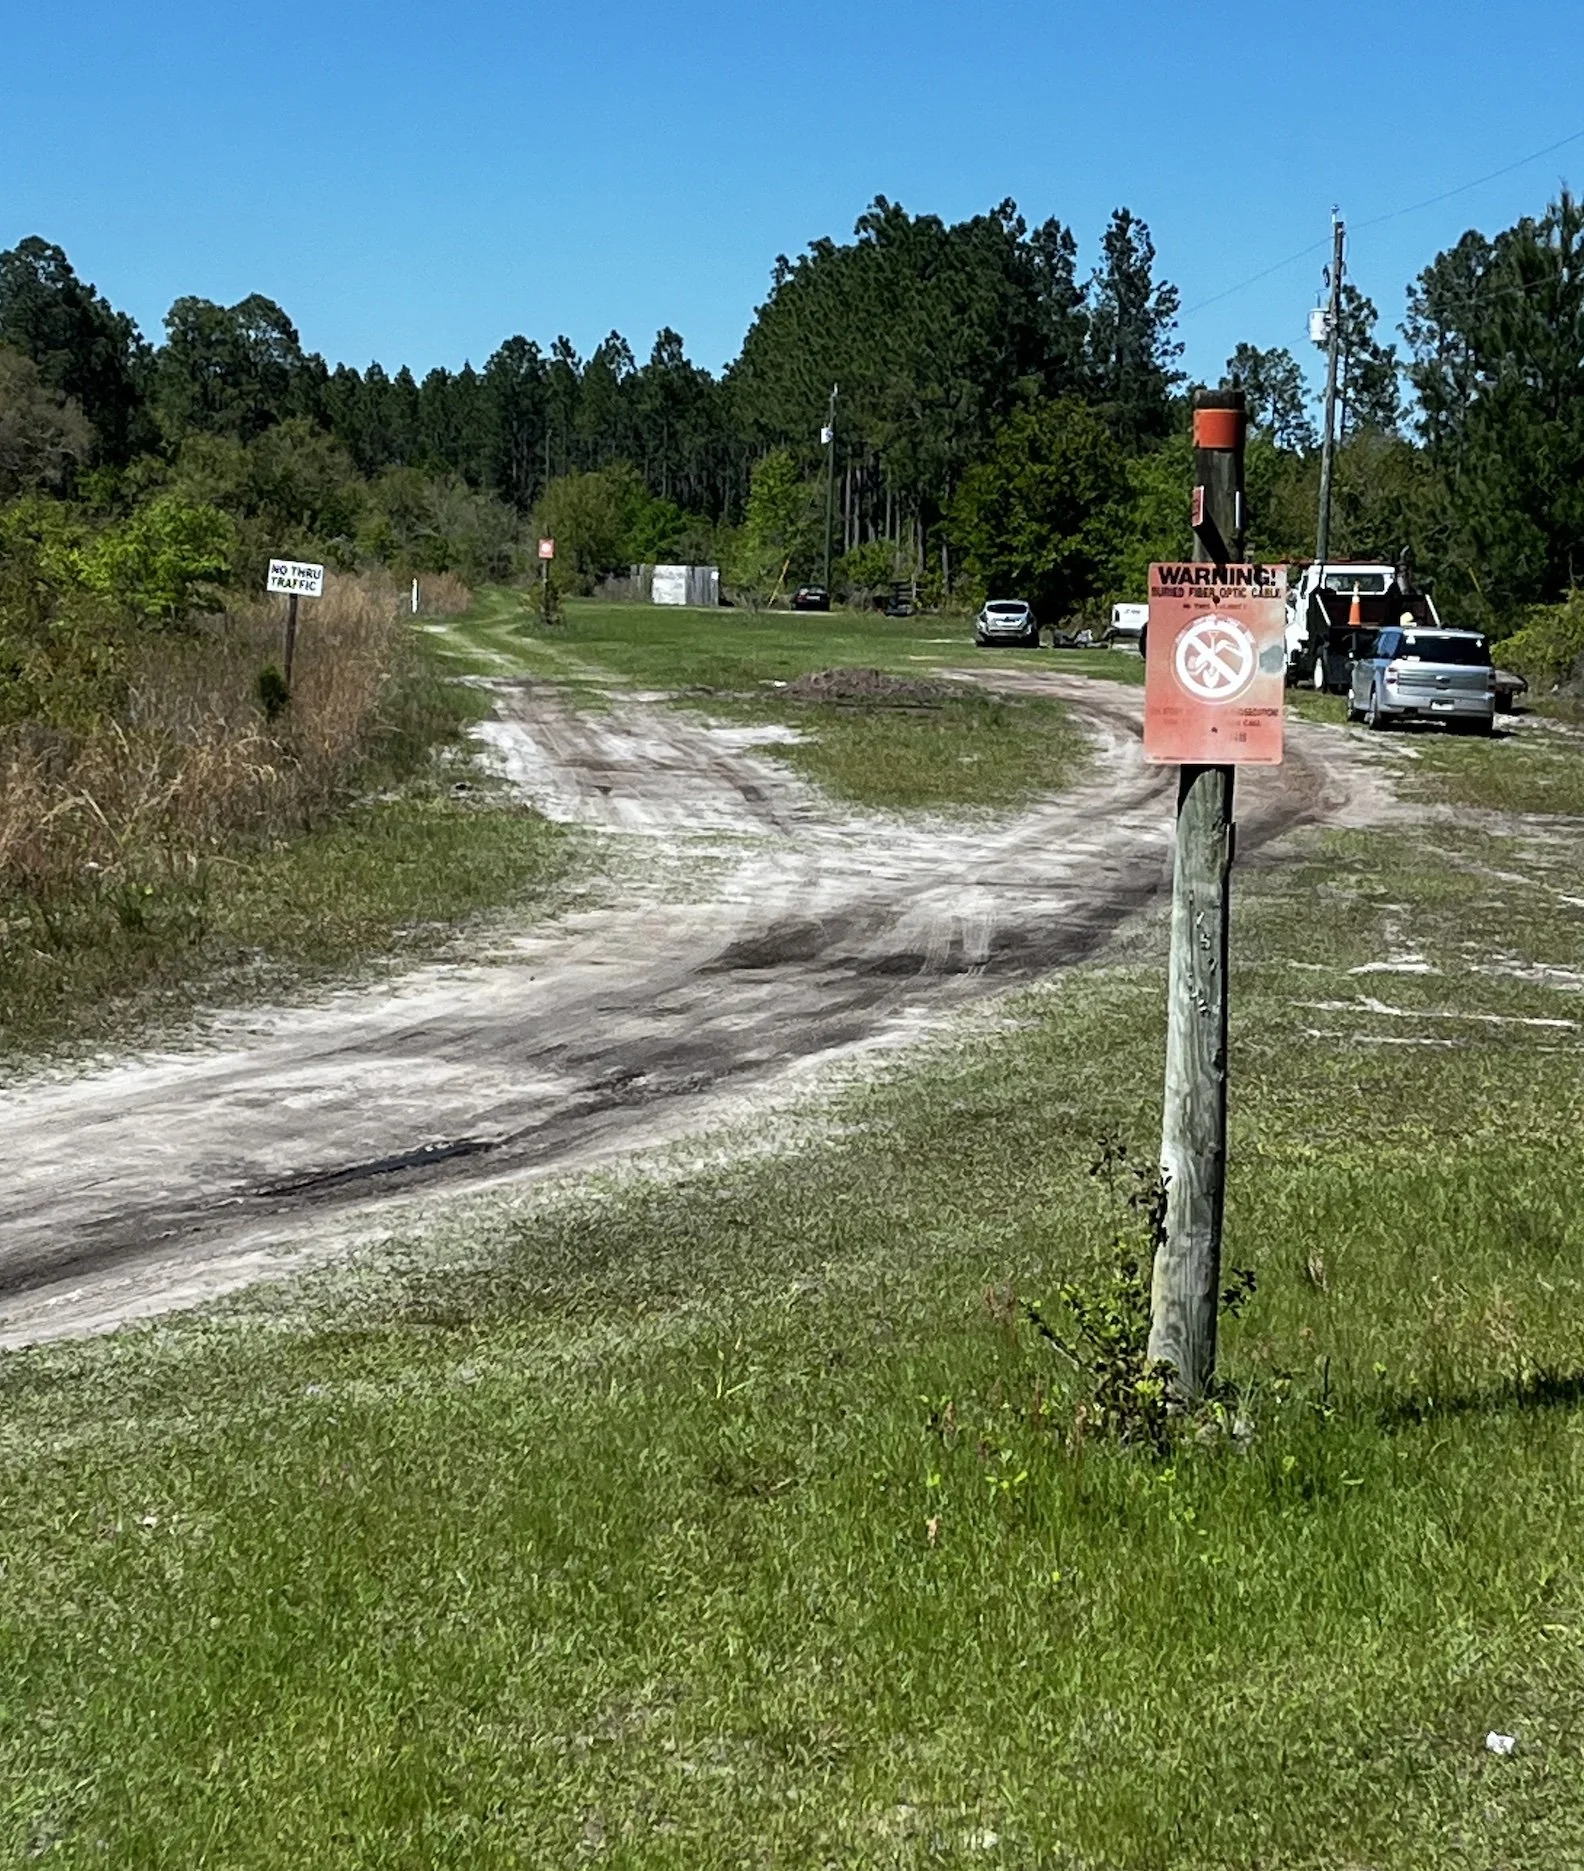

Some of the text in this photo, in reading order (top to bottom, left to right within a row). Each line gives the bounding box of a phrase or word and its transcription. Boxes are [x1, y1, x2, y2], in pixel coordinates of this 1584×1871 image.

[271, 564, 321, 580] NO THRU
[1158, 566, 1276, 586] WARNING!
[271, 576, 316, 591] TRAFFIC
[1151, 587, 1185, 598] BURIED
[1189, 587, 1215, 598] FIBER
[1219, 587, 1247, 598] OPTIC
